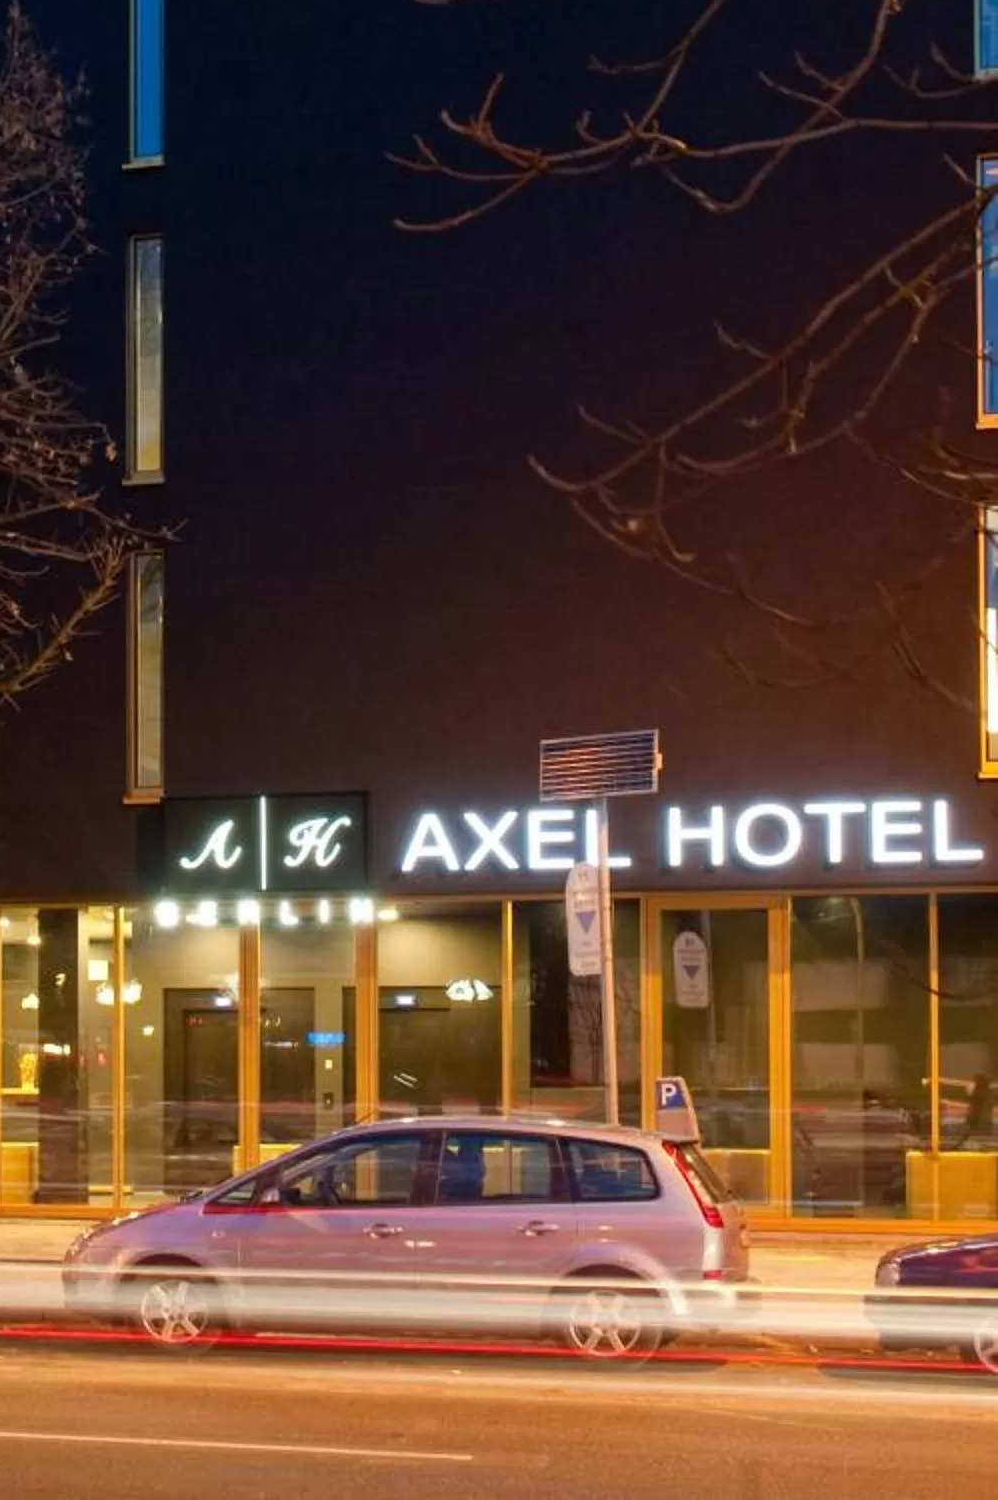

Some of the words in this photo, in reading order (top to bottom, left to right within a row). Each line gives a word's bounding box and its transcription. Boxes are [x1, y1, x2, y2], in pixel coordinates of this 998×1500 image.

[400, 808, 632, 872] AXEL
[667, 799, 985, 868] HOTEL
[661, 1083, 678, 1106] P
